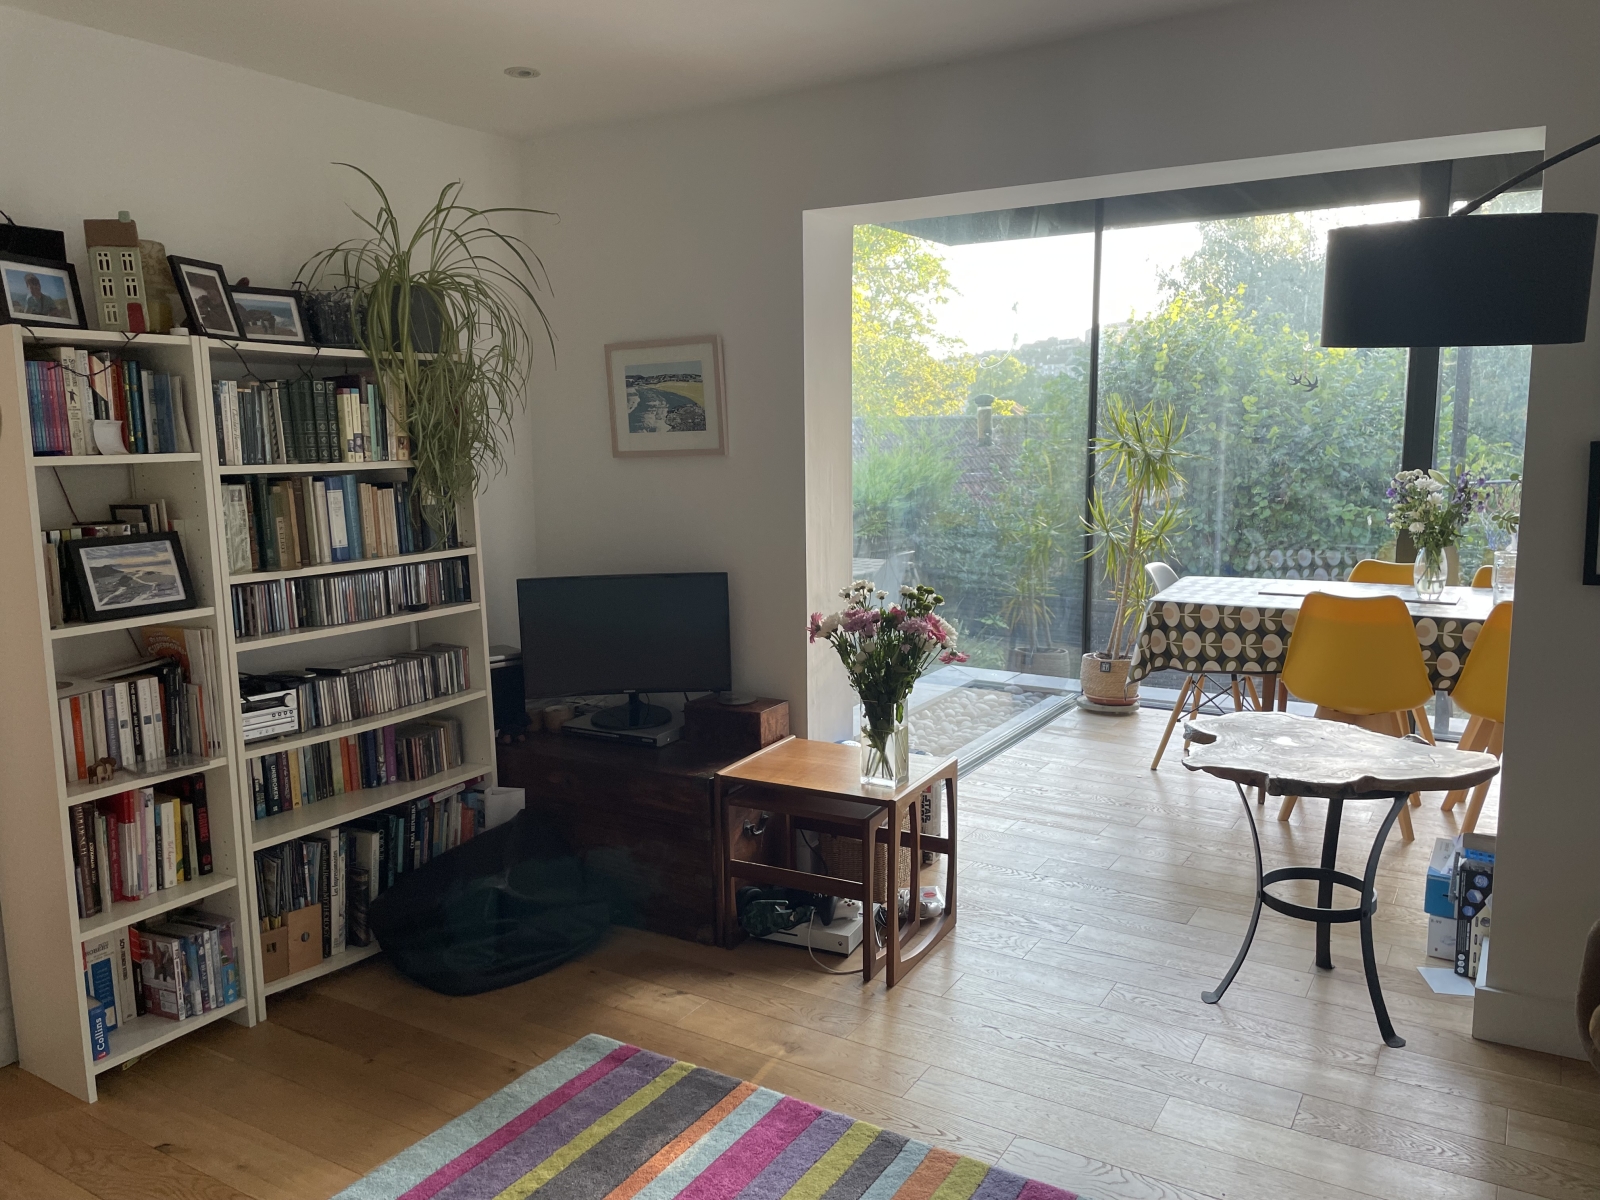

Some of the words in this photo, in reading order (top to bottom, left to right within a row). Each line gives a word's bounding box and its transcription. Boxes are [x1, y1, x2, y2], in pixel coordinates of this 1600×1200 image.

[129, 694, 138, 713] BRIDGE
[133, 726, 141, 745] BANKS
[270, 764, 278, 799] UNBROKEN
[74, 806, 83, 824] JUDI
[924, 795, 932, 824] STAR
[198, 812, 208, 838] CRIME
[77, 825, 88, 854] DENCH
[95, 1018, 105, 1050] Collins
